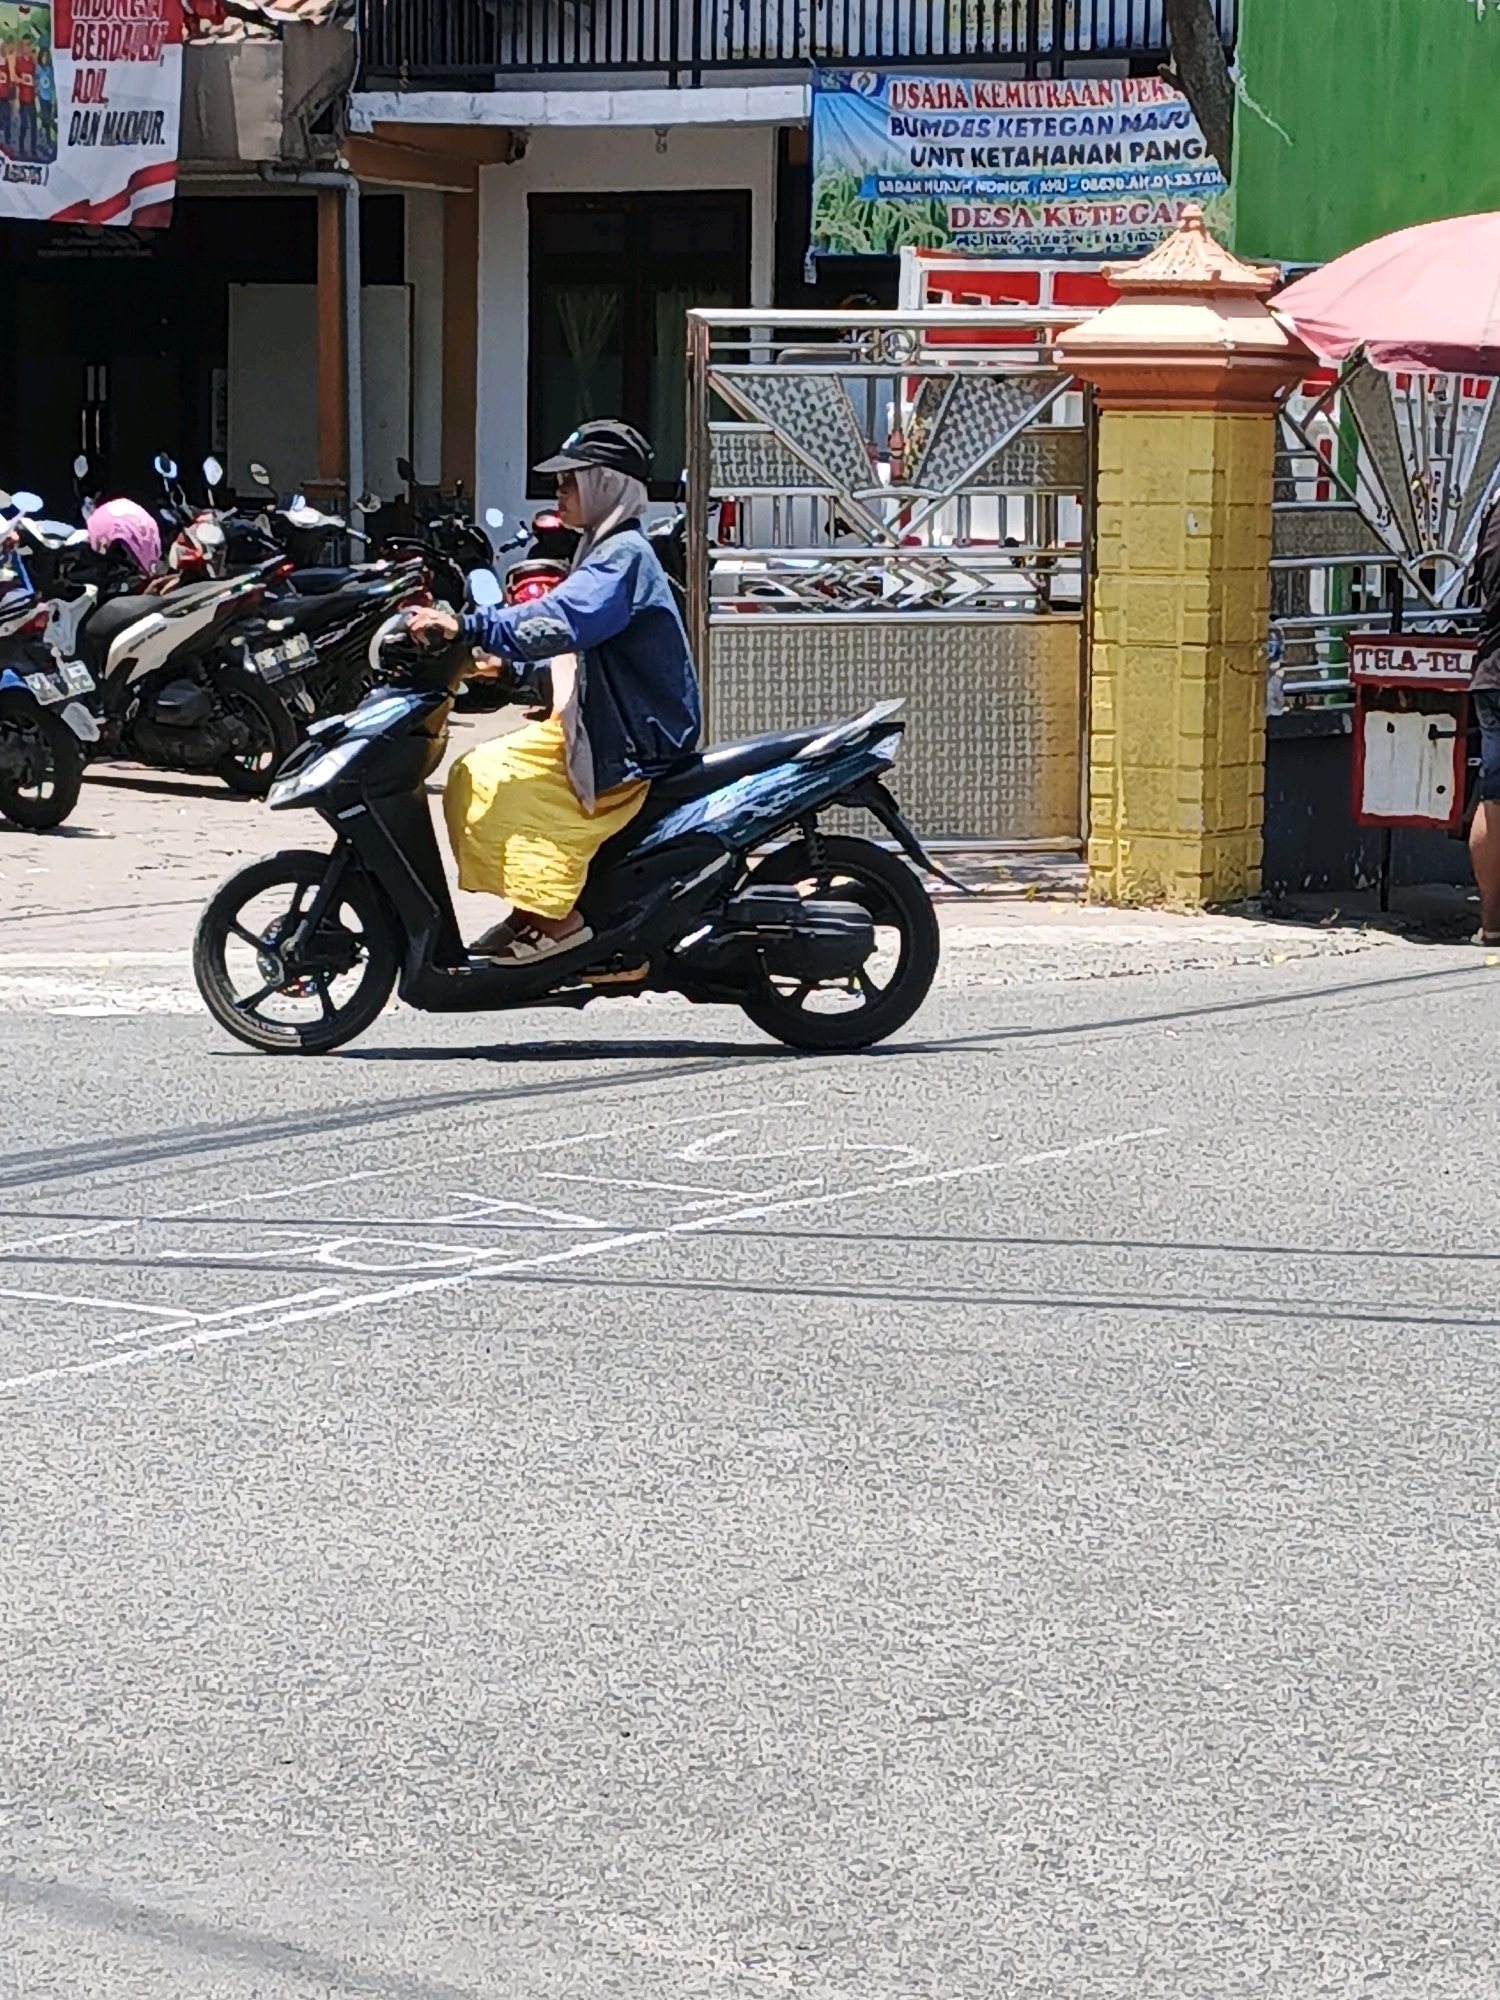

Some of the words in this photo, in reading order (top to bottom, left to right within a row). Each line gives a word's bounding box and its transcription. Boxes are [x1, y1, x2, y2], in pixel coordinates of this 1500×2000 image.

[892, 82, 969, 109] USAHA
[974, 80, 1114, 108] KEMITRAAN
[68, 110, 102, 147] DAN
[890, 116, 992, 138] BUMDES
[996, 115, 1114, 138] KETEGAN
[1119, 111, 1191, 133] MAJU
[910, 145, 965, 169] UNIT
[970, 141, 1122, 169] KETAHANAN
[951, 207, 1034, 229] DESA
